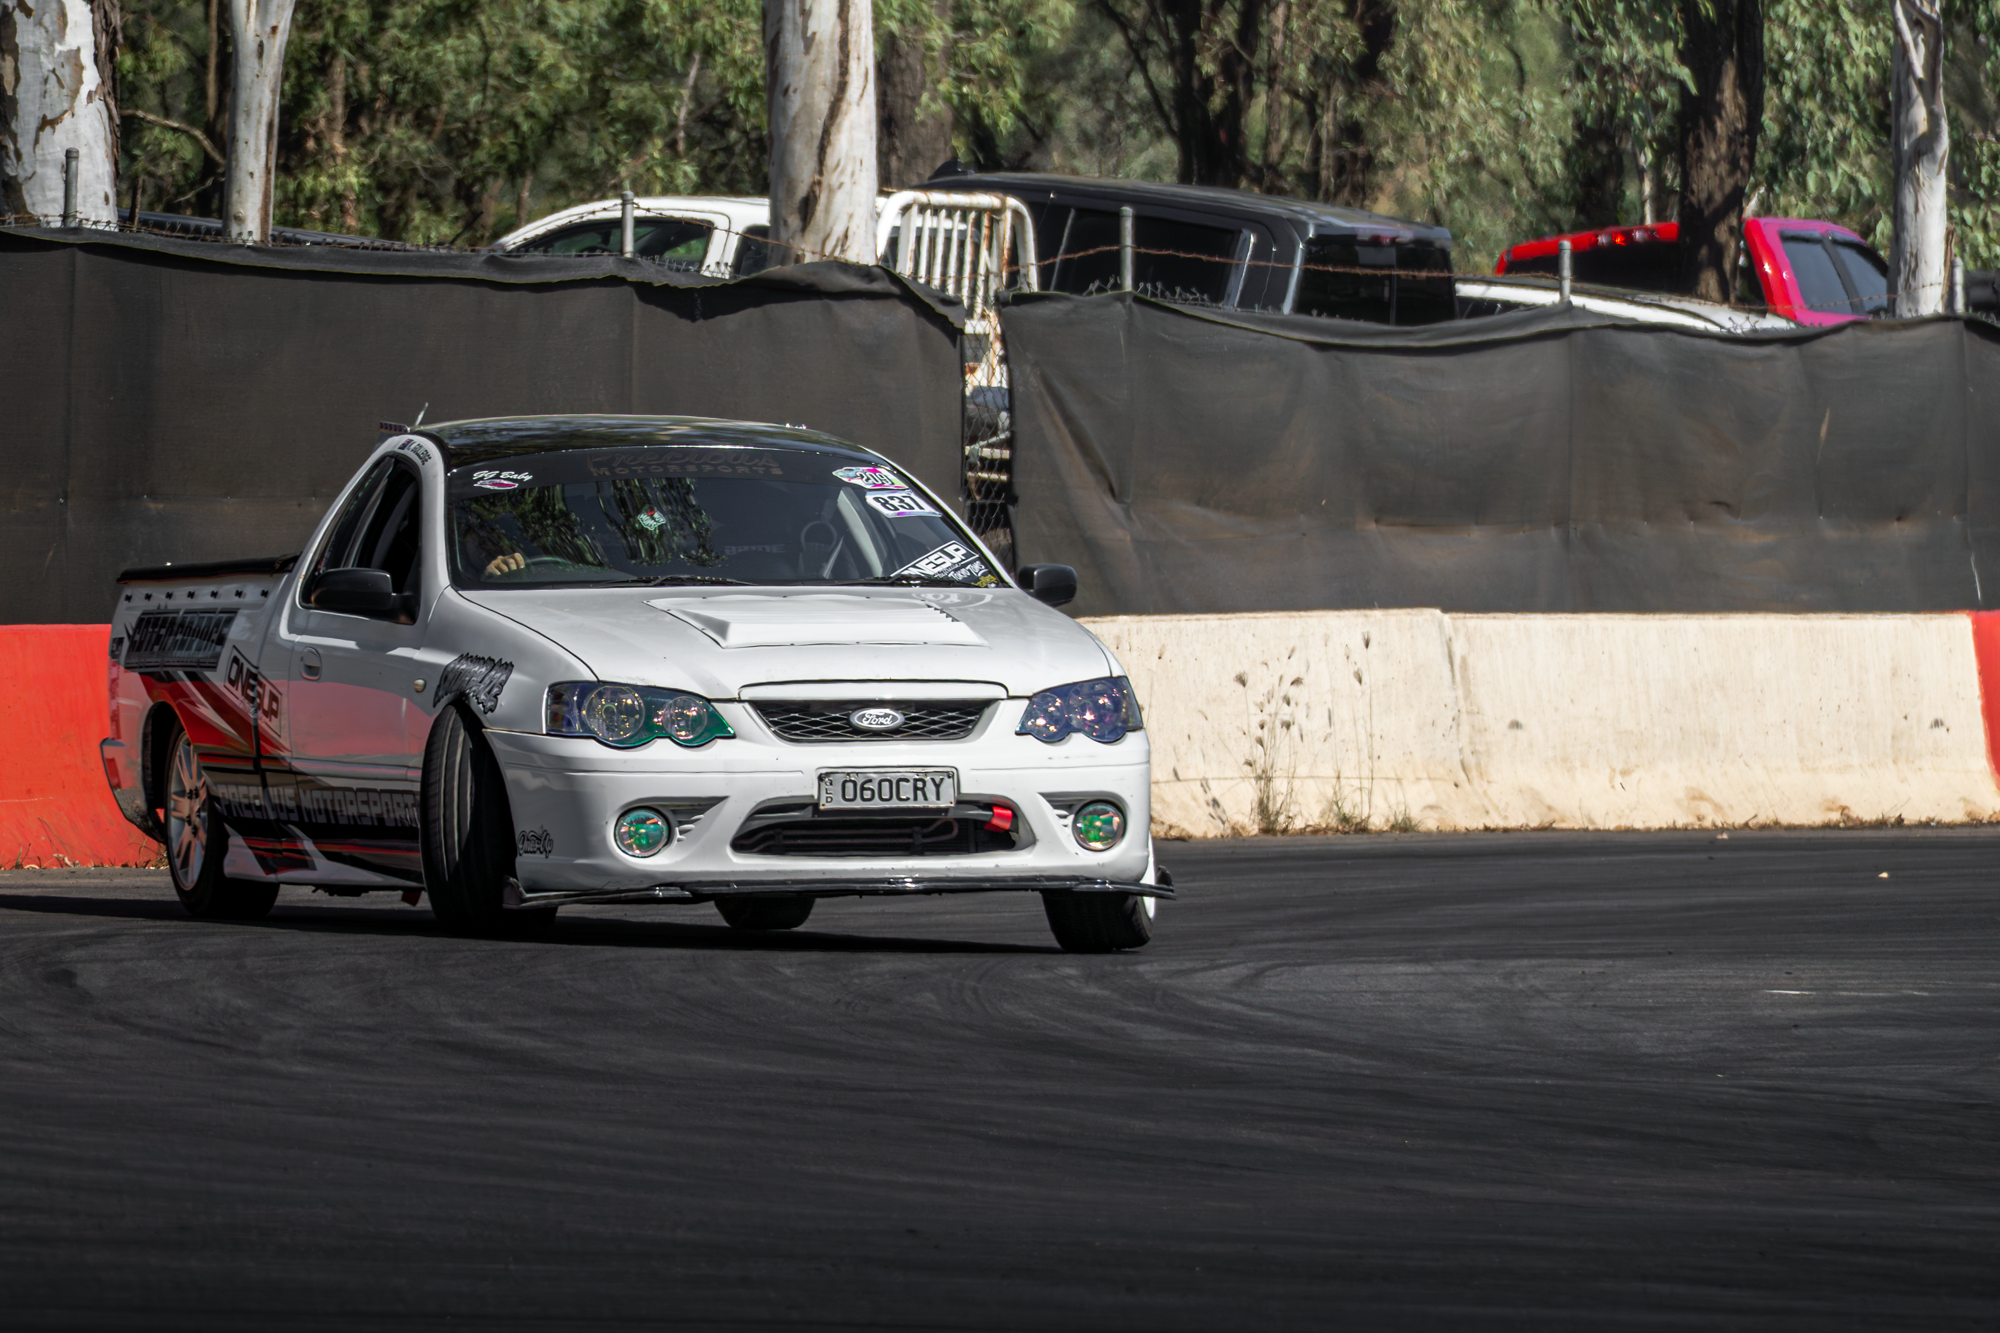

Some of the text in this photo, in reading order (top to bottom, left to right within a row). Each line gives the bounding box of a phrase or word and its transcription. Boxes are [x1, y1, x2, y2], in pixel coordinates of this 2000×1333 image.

[499, 471, 533, 482] Baby
[591, 464, 783, 477] MOTORSPORTS
[872, 495, 925, 512] 837
[861, 710, 893, 725] Ford
[841, 777, 945, 802] 060CRY
